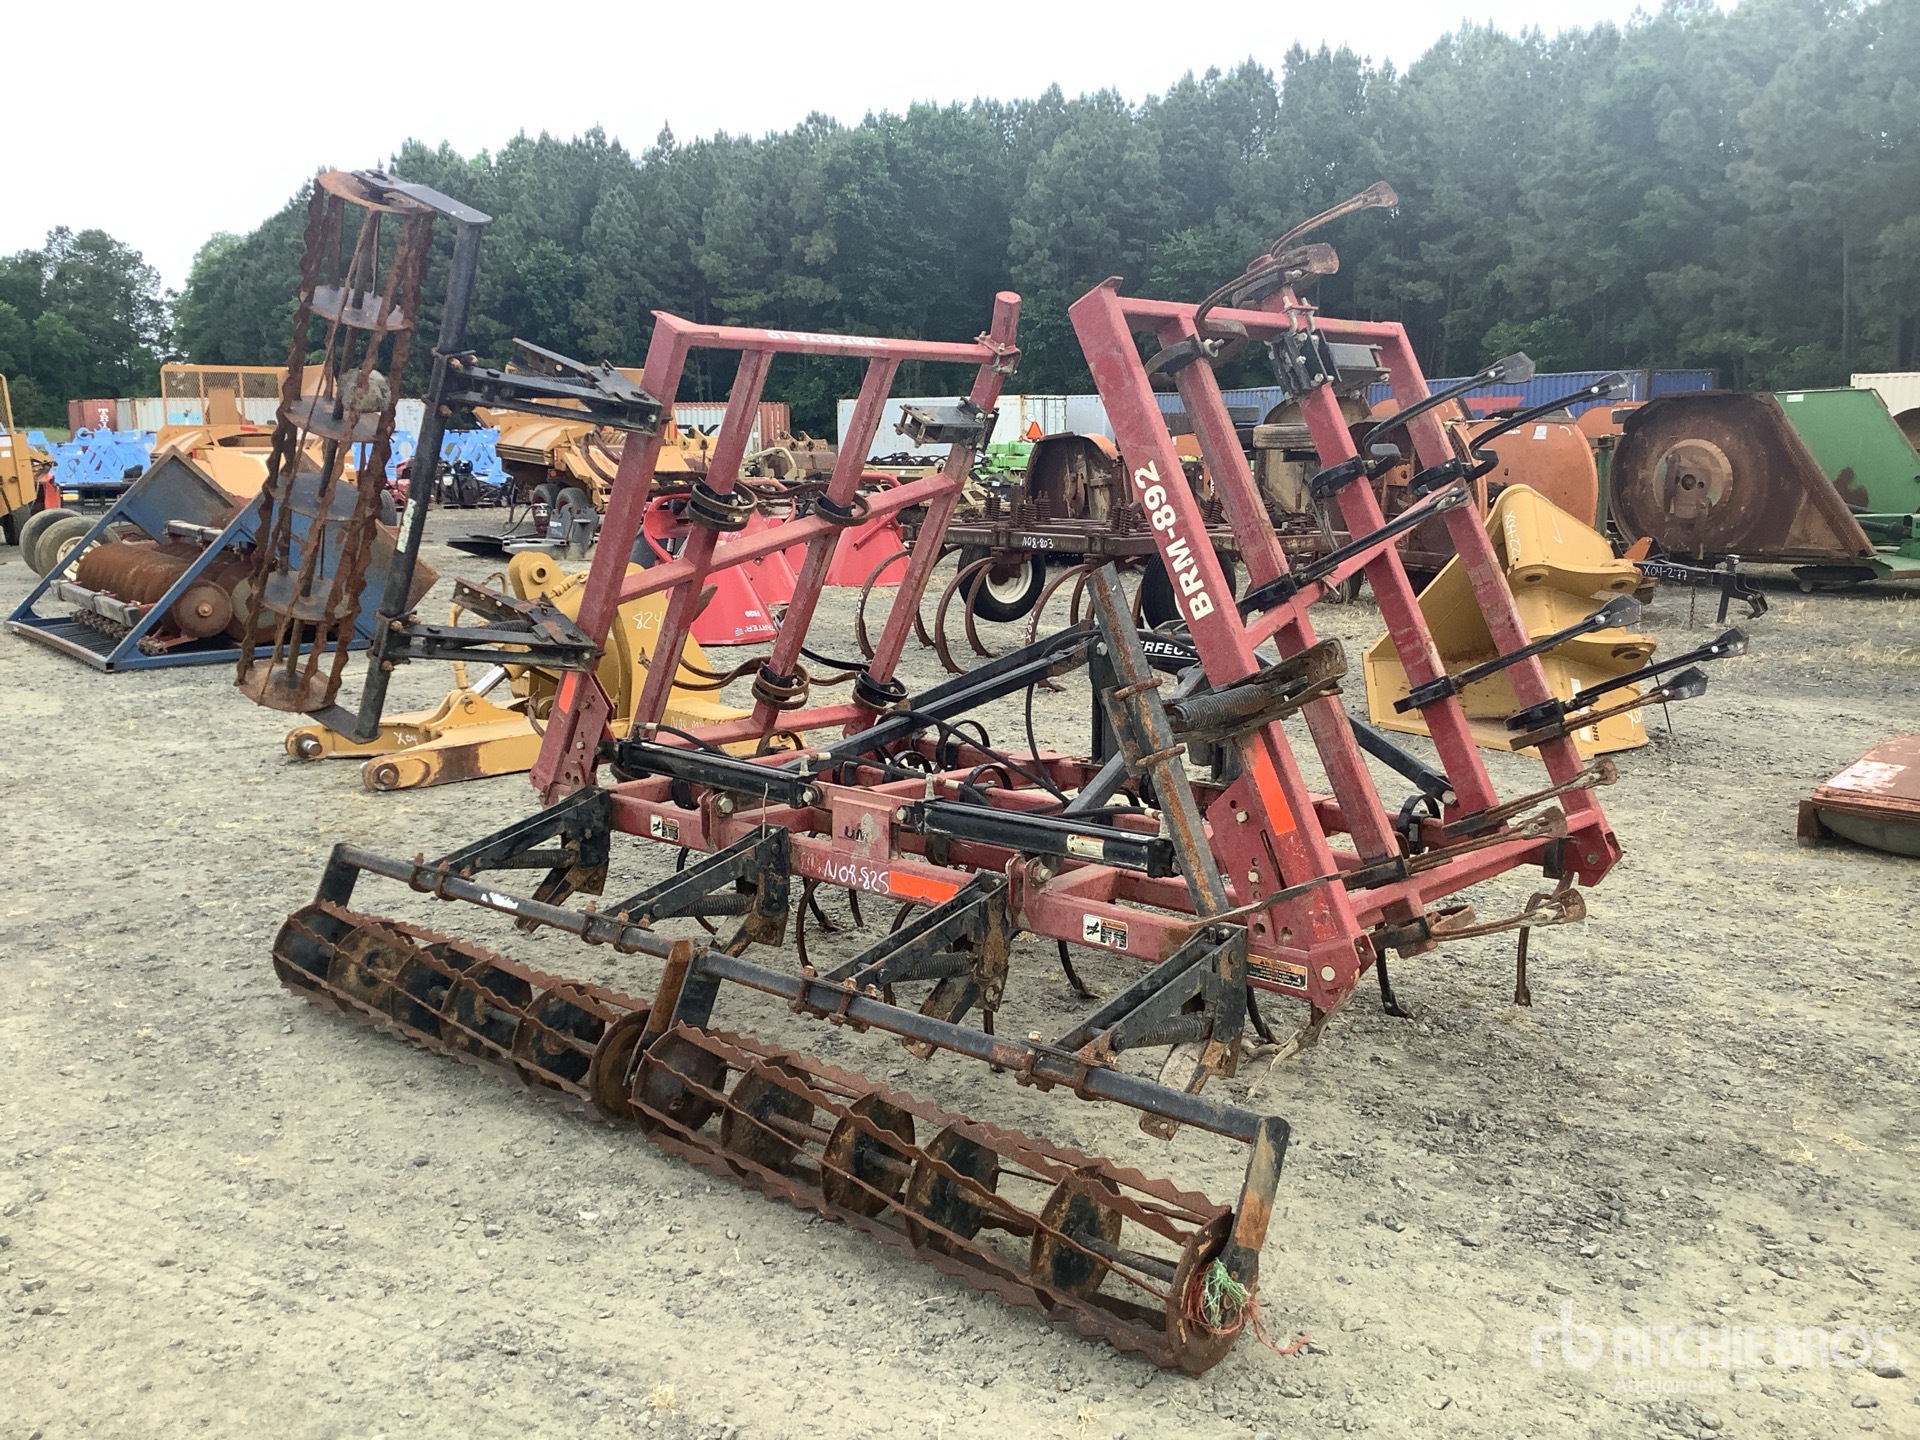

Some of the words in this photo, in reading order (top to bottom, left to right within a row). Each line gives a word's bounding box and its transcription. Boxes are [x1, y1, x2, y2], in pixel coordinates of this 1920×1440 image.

[1134, 460, 1214, 621] BRM-892
[1644, 565, 1688, 580] X04-277
[632, 611, 663, 633] 824
